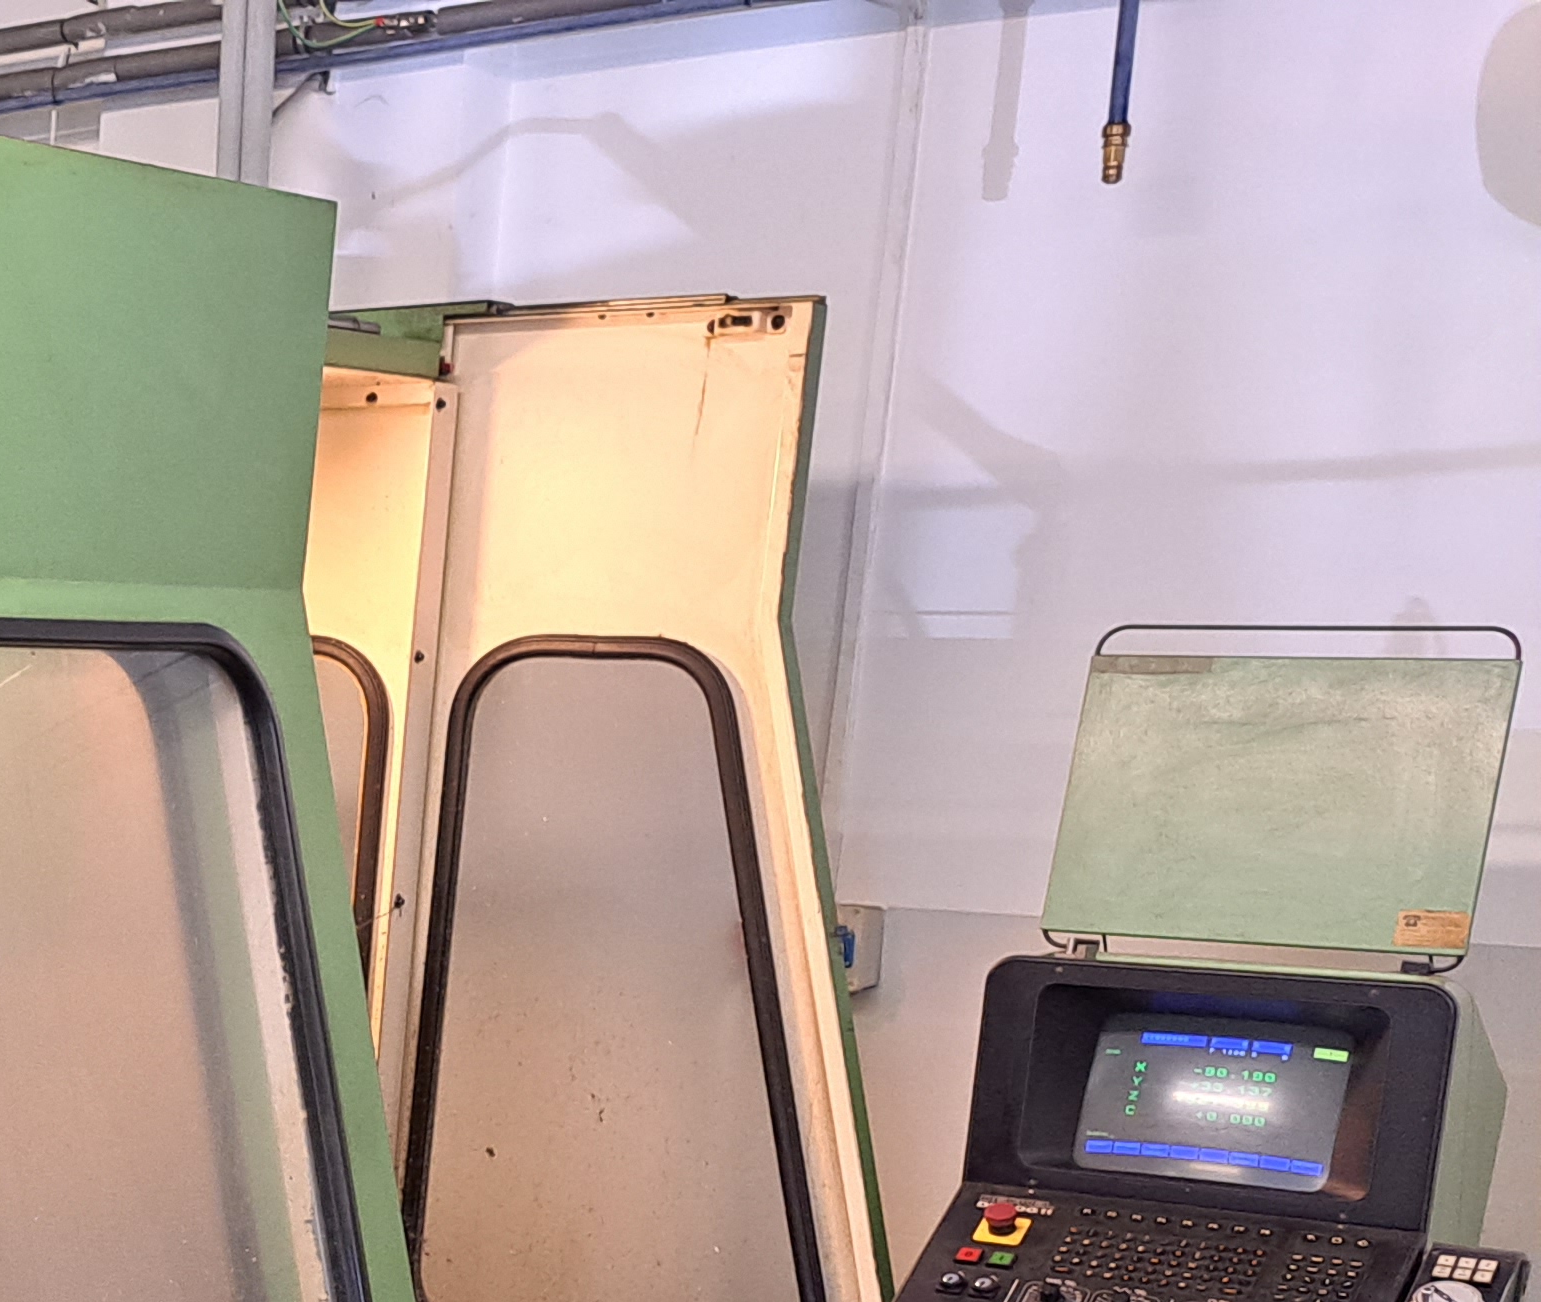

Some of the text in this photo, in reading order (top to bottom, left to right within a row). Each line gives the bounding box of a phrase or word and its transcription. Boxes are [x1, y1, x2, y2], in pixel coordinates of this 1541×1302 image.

[1135, 1061, 1147, 1072] X
[1132, 1076, 1143, 1086] Y
[1128, 1090, 1139, 1101] Z
[1125, 1105, 1136, 1115] C
